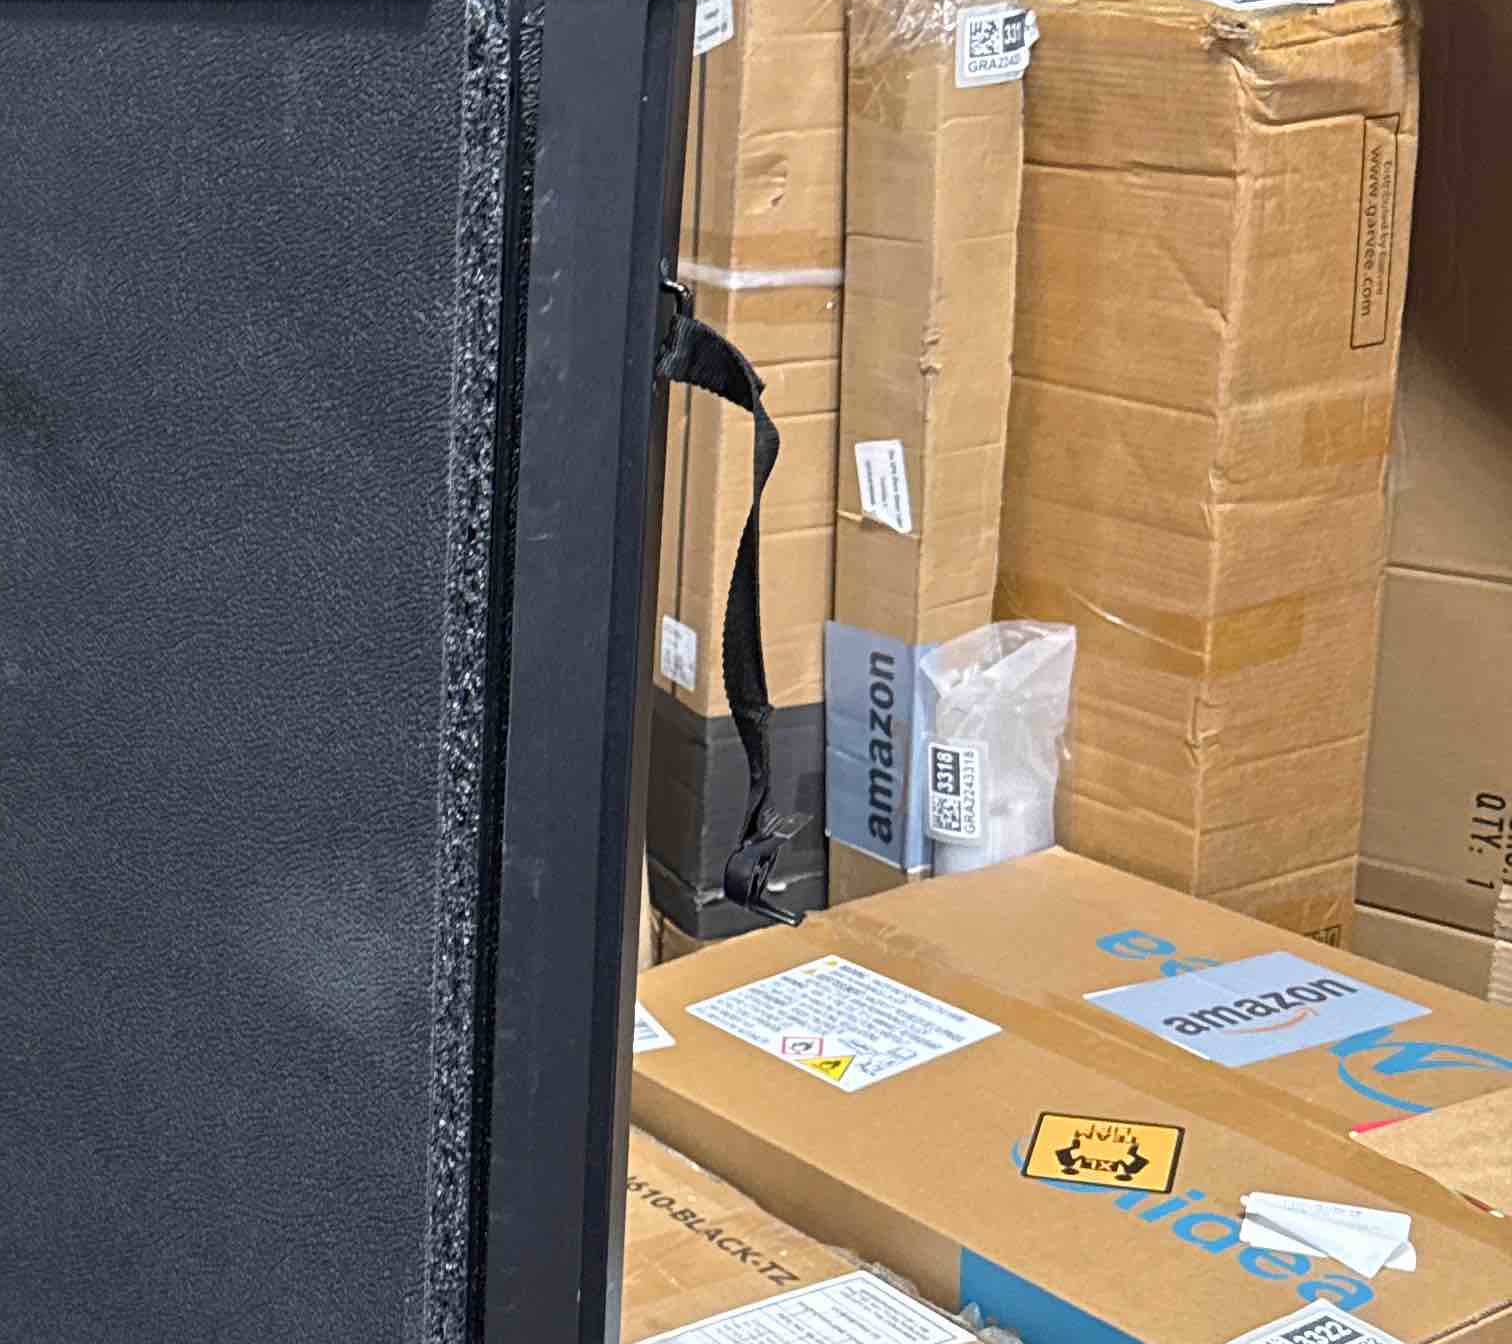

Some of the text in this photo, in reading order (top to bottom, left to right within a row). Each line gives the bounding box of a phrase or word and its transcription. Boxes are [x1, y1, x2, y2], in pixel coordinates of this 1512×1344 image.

[1361, 144, 1381, 318] www.garvee.com
[868, 651, 897, 844] amazon
[936, 749, 954, 795] 3318
[1468, 791, 1507, 855] QTY:
[1162, 975, 1360, 1038] amazon
